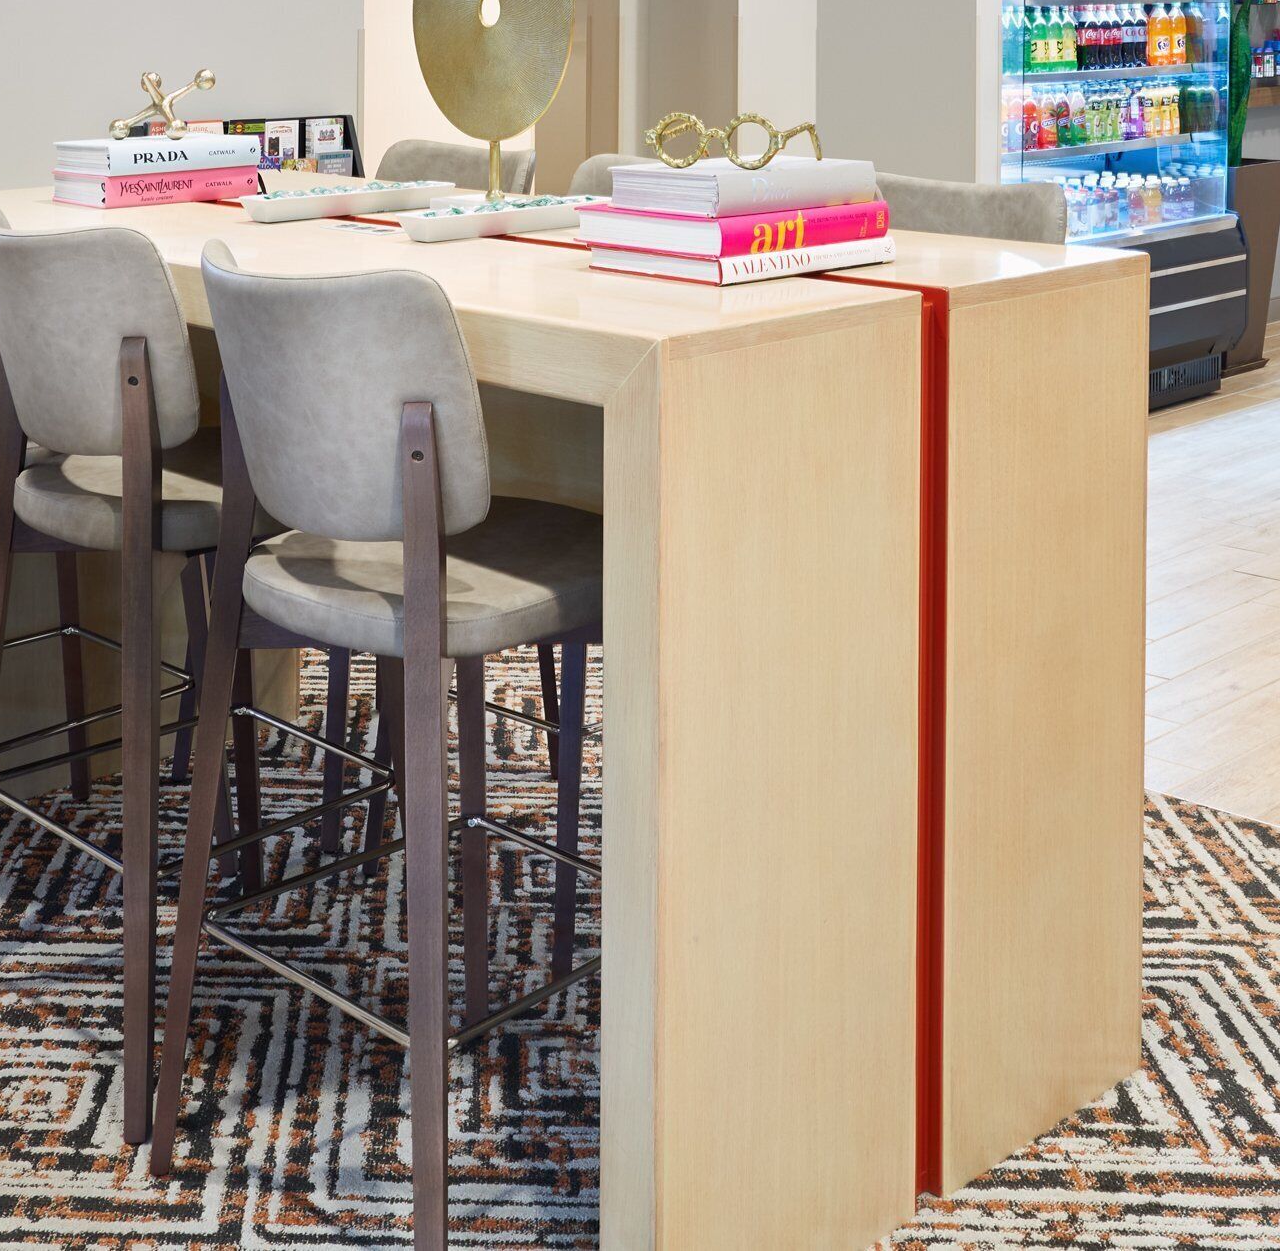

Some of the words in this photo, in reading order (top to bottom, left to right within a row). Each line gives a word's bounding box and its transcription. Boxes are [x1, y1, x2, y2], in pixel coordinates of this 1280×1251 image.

[133, 150, 189, 164] PRADA
[751, 177, 792, 202] Dior
[751, 210, 807, 255] art
[732, 253, 810, 275] VALENTINO
